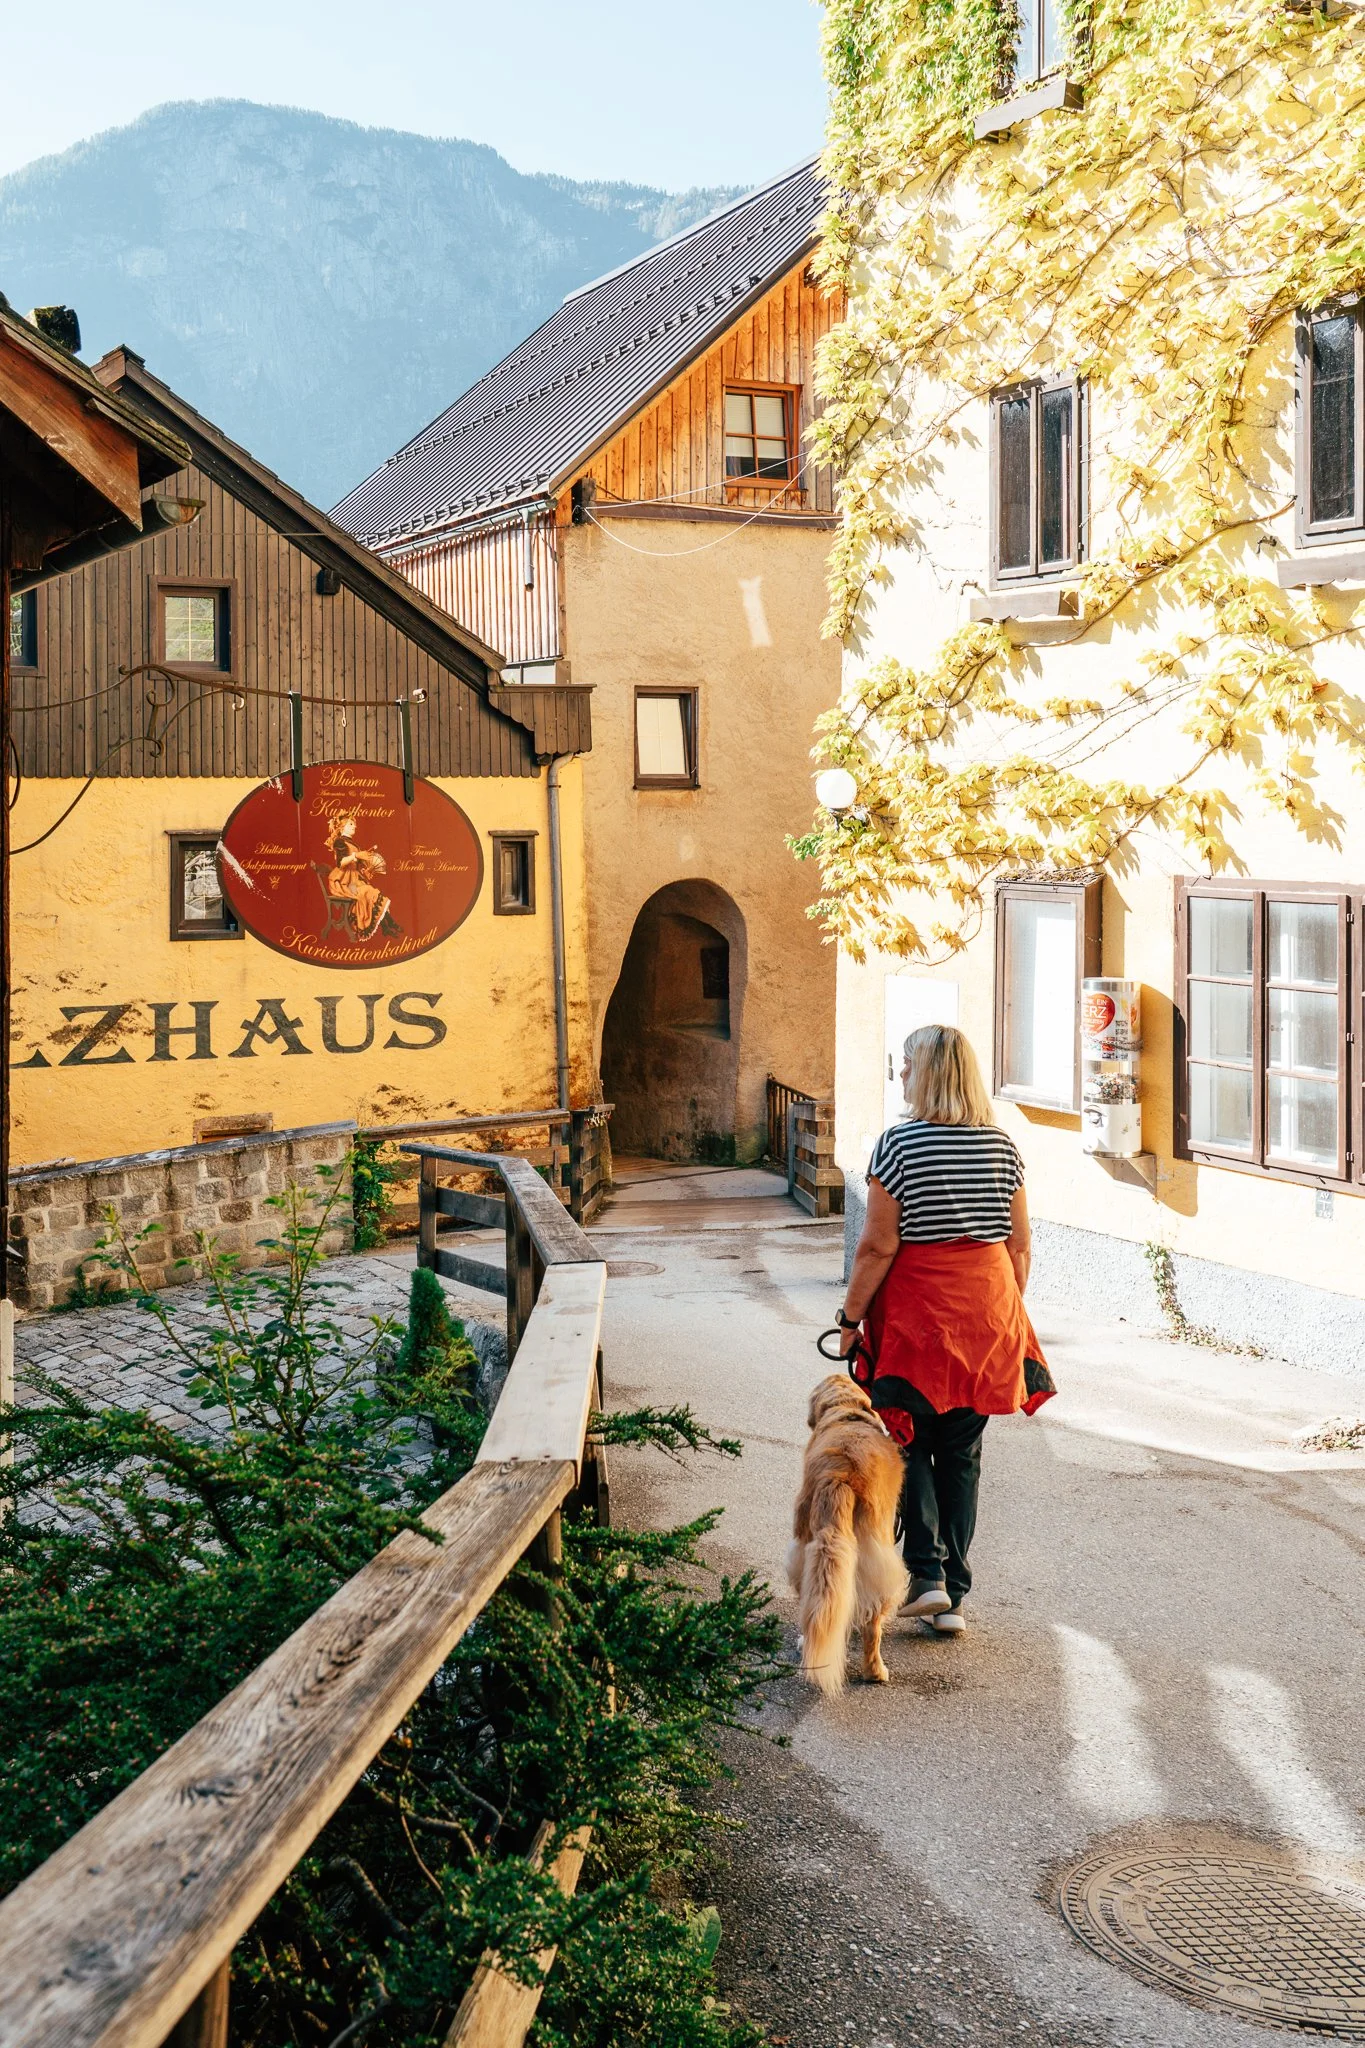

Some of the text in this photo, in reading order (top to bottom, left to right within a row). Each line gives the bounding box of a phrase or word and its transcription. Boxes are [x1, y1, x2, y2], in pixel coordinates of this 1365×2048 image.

[320, 767, 380, 787] Museum
[309, 797, 396, 818] Kunstkontor
[254, 842, 293, 855] Hallstatt
[410, 845, 442, 856] Familie
[240, 859, 307, 874] Salzkammergut
[433, 860, 469, 872] Hinterer
[279, 925, 438, 961] Kuriositätenkabinett
[1083, 1005, 1107, 1019] ERZ
